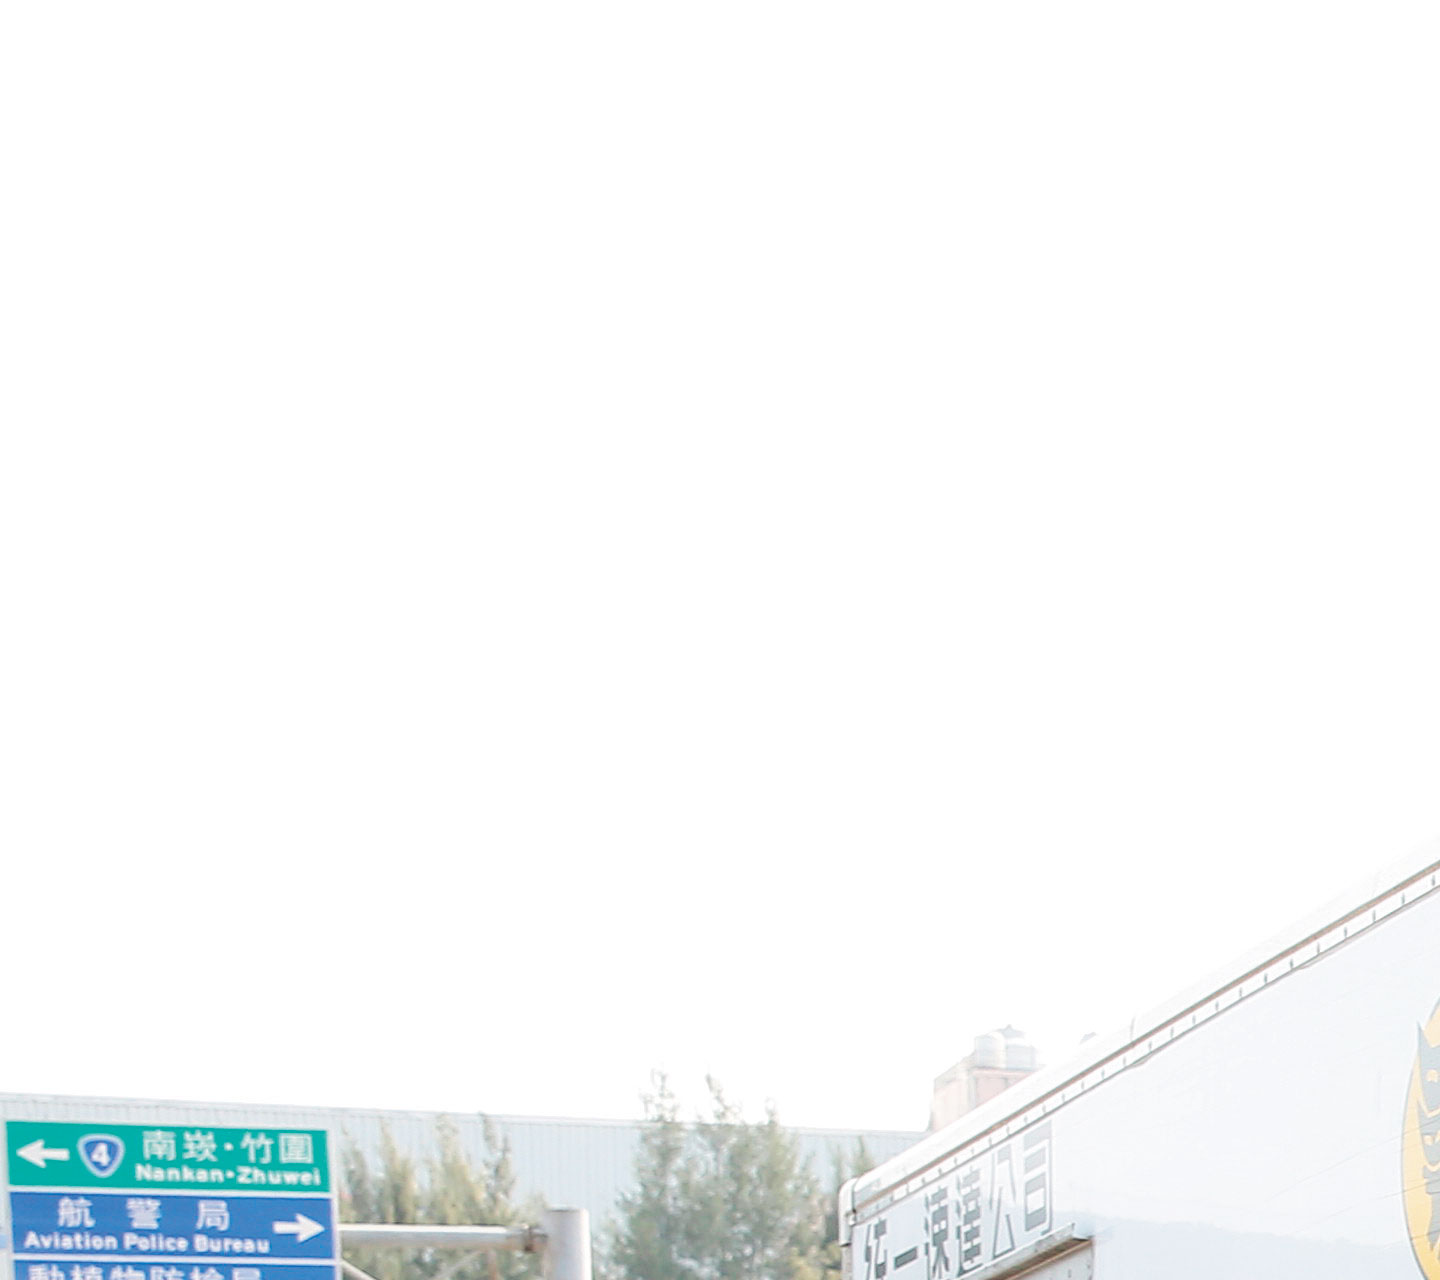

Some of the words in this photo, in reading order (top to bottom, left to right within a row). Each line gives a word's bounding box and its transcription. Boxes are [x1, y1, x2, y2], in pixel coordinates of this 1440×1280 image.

[91, 1143, 111, 1167] 4
[57, 1197, 231, 1232] 航警局
[23, 1230, 118, 1251] Aviation
[123, 1234, 189, 1253] Police
[194, 1236, 271, 1254] Bureau
